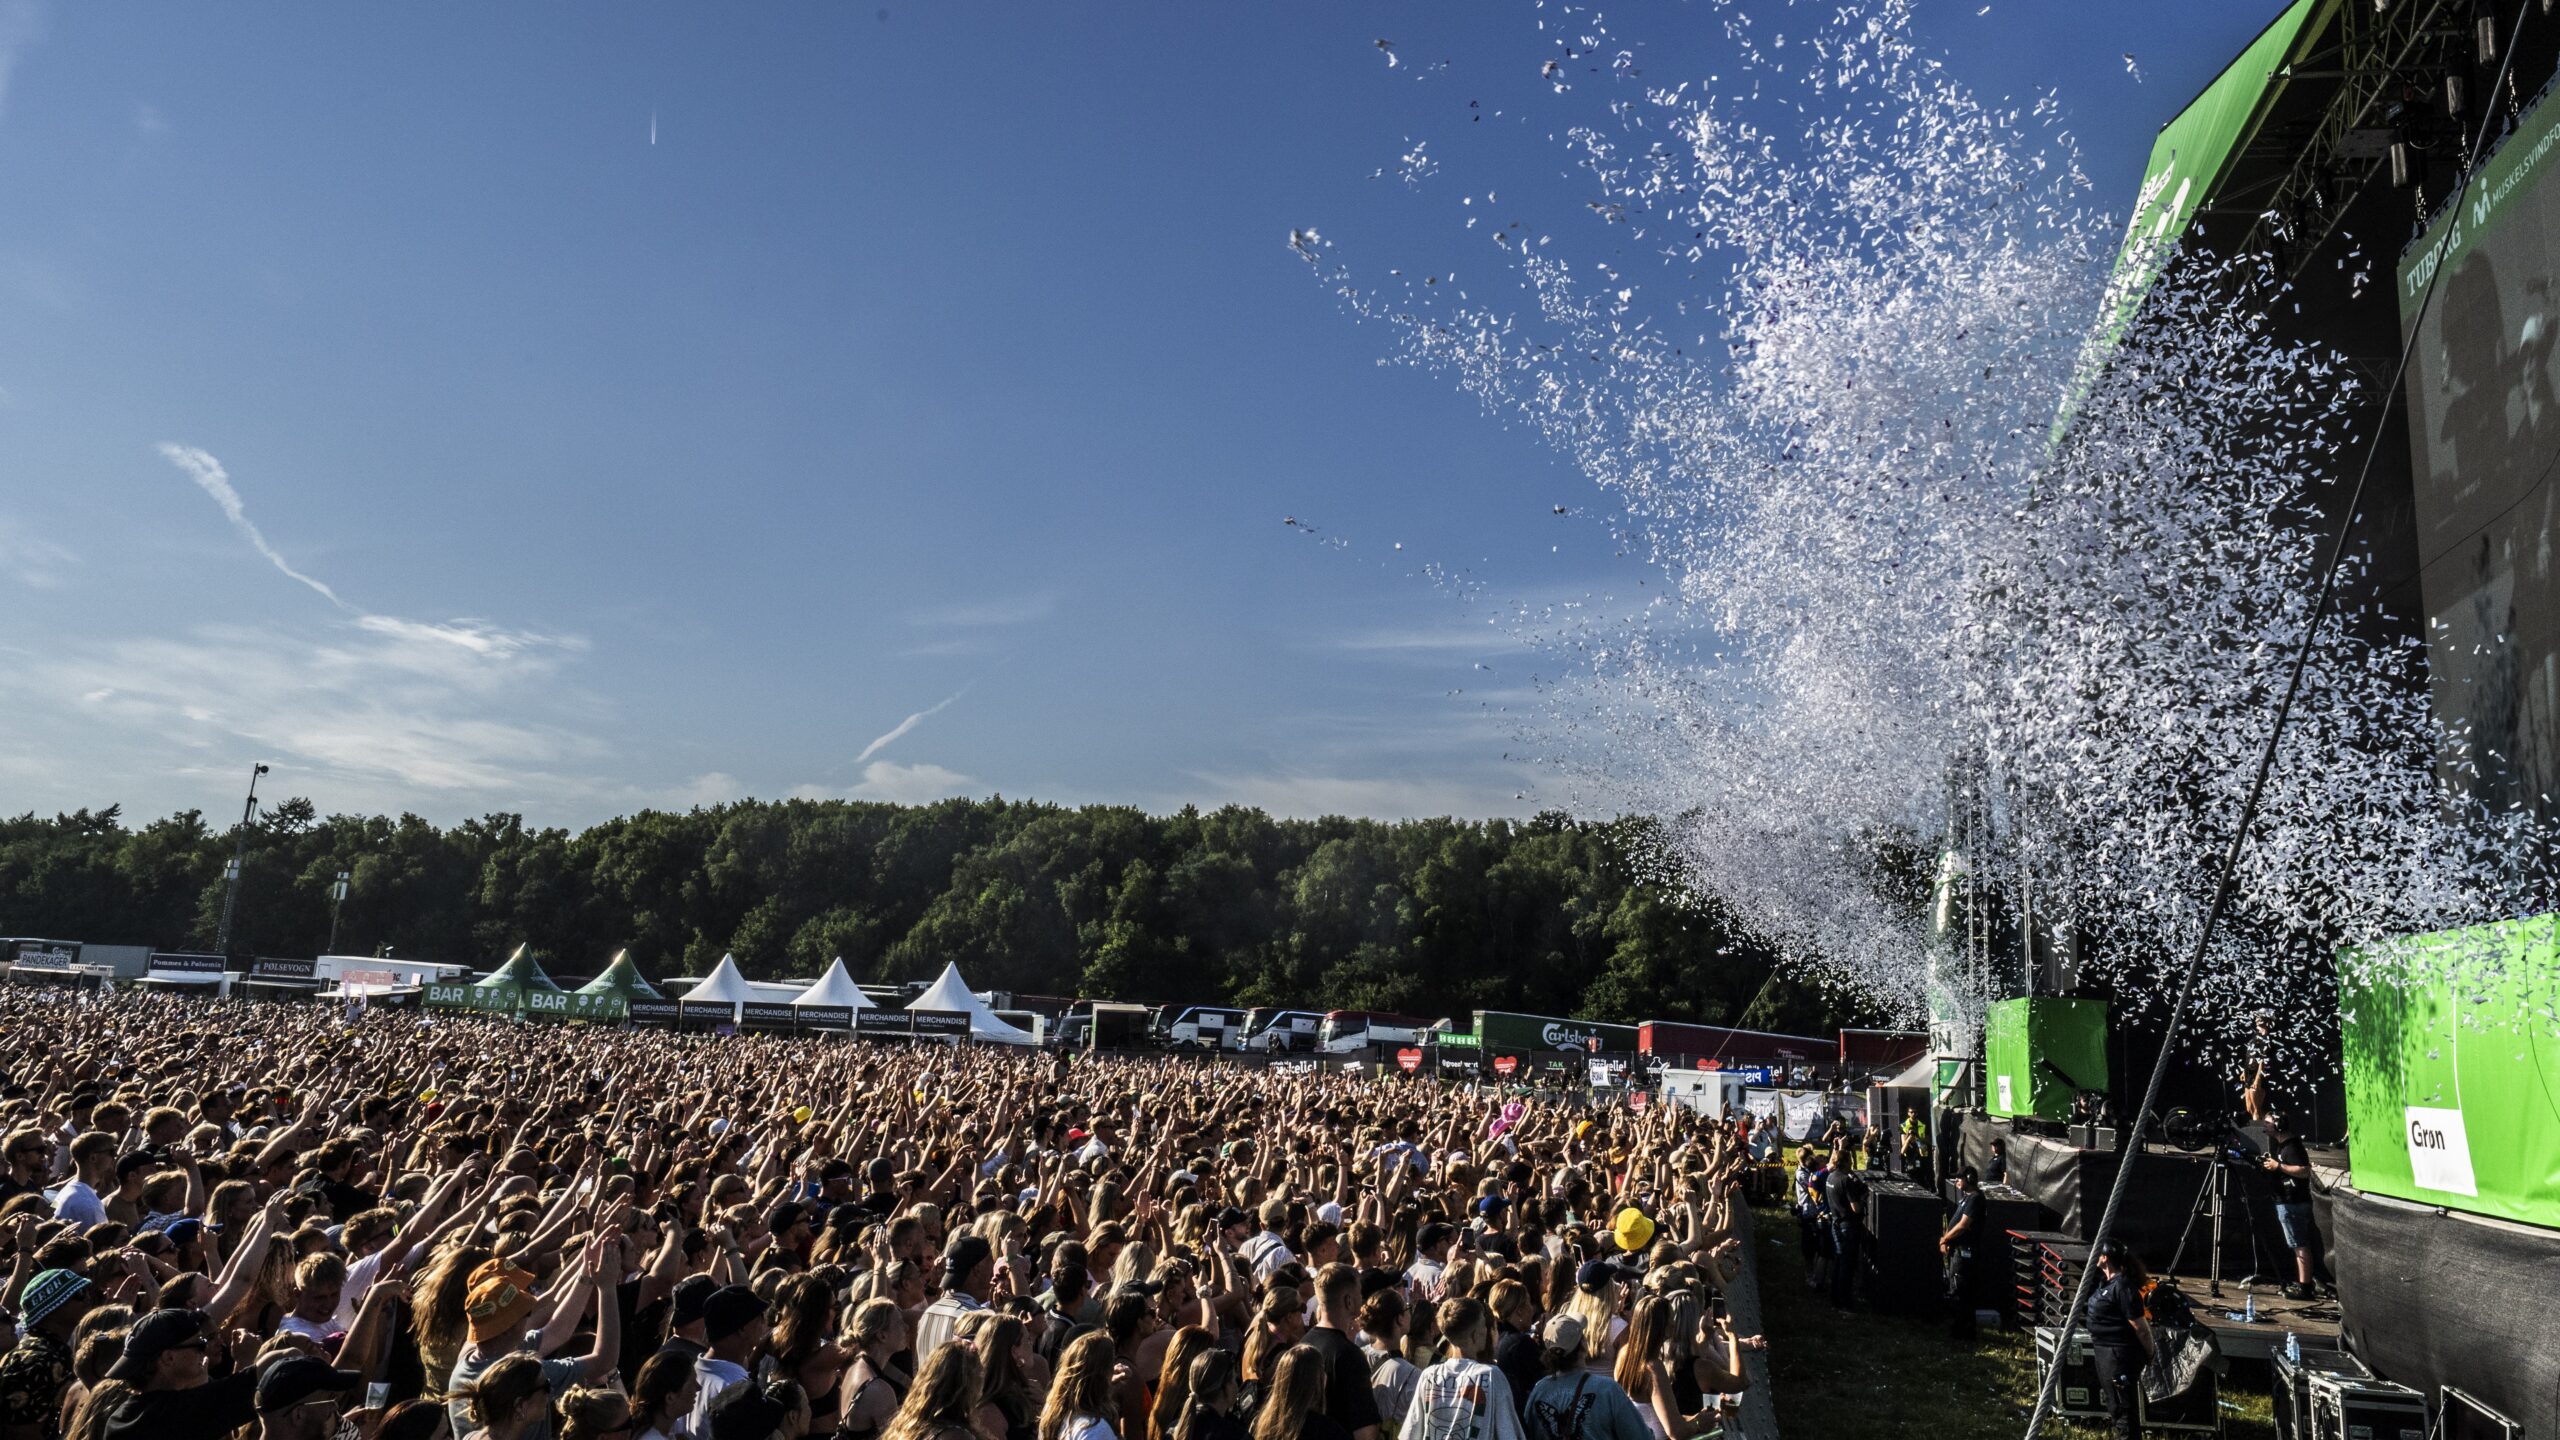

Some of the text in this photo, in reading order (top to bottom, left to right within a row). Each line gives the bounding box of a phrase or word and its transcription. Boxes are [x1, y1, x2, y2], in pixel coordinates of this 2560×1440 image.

[23, 954, 67, 966] PANDEKAGER
[153, 959, 181, 967] Pommes
[263, 962, 311, 972] PØLSEVOGN
[429, 986, 464, 1002] BAR
[531, 993, 567, 1010] BAR
[633, 1004, 678, 1012] MERCHANDISE
[684, 1005, 732, 1015] MERCHANDISE
[744, 1008, 793, 1017] MERCHANDISE
[799, 1010, 849, 1019] MERCHANDISE
[859, 1013, 910, 1022] MERCHANDISE
[916, 1015, 967, 1025] MERCHANDISE
[2411, 1119, 2446, 1150] Grøn
